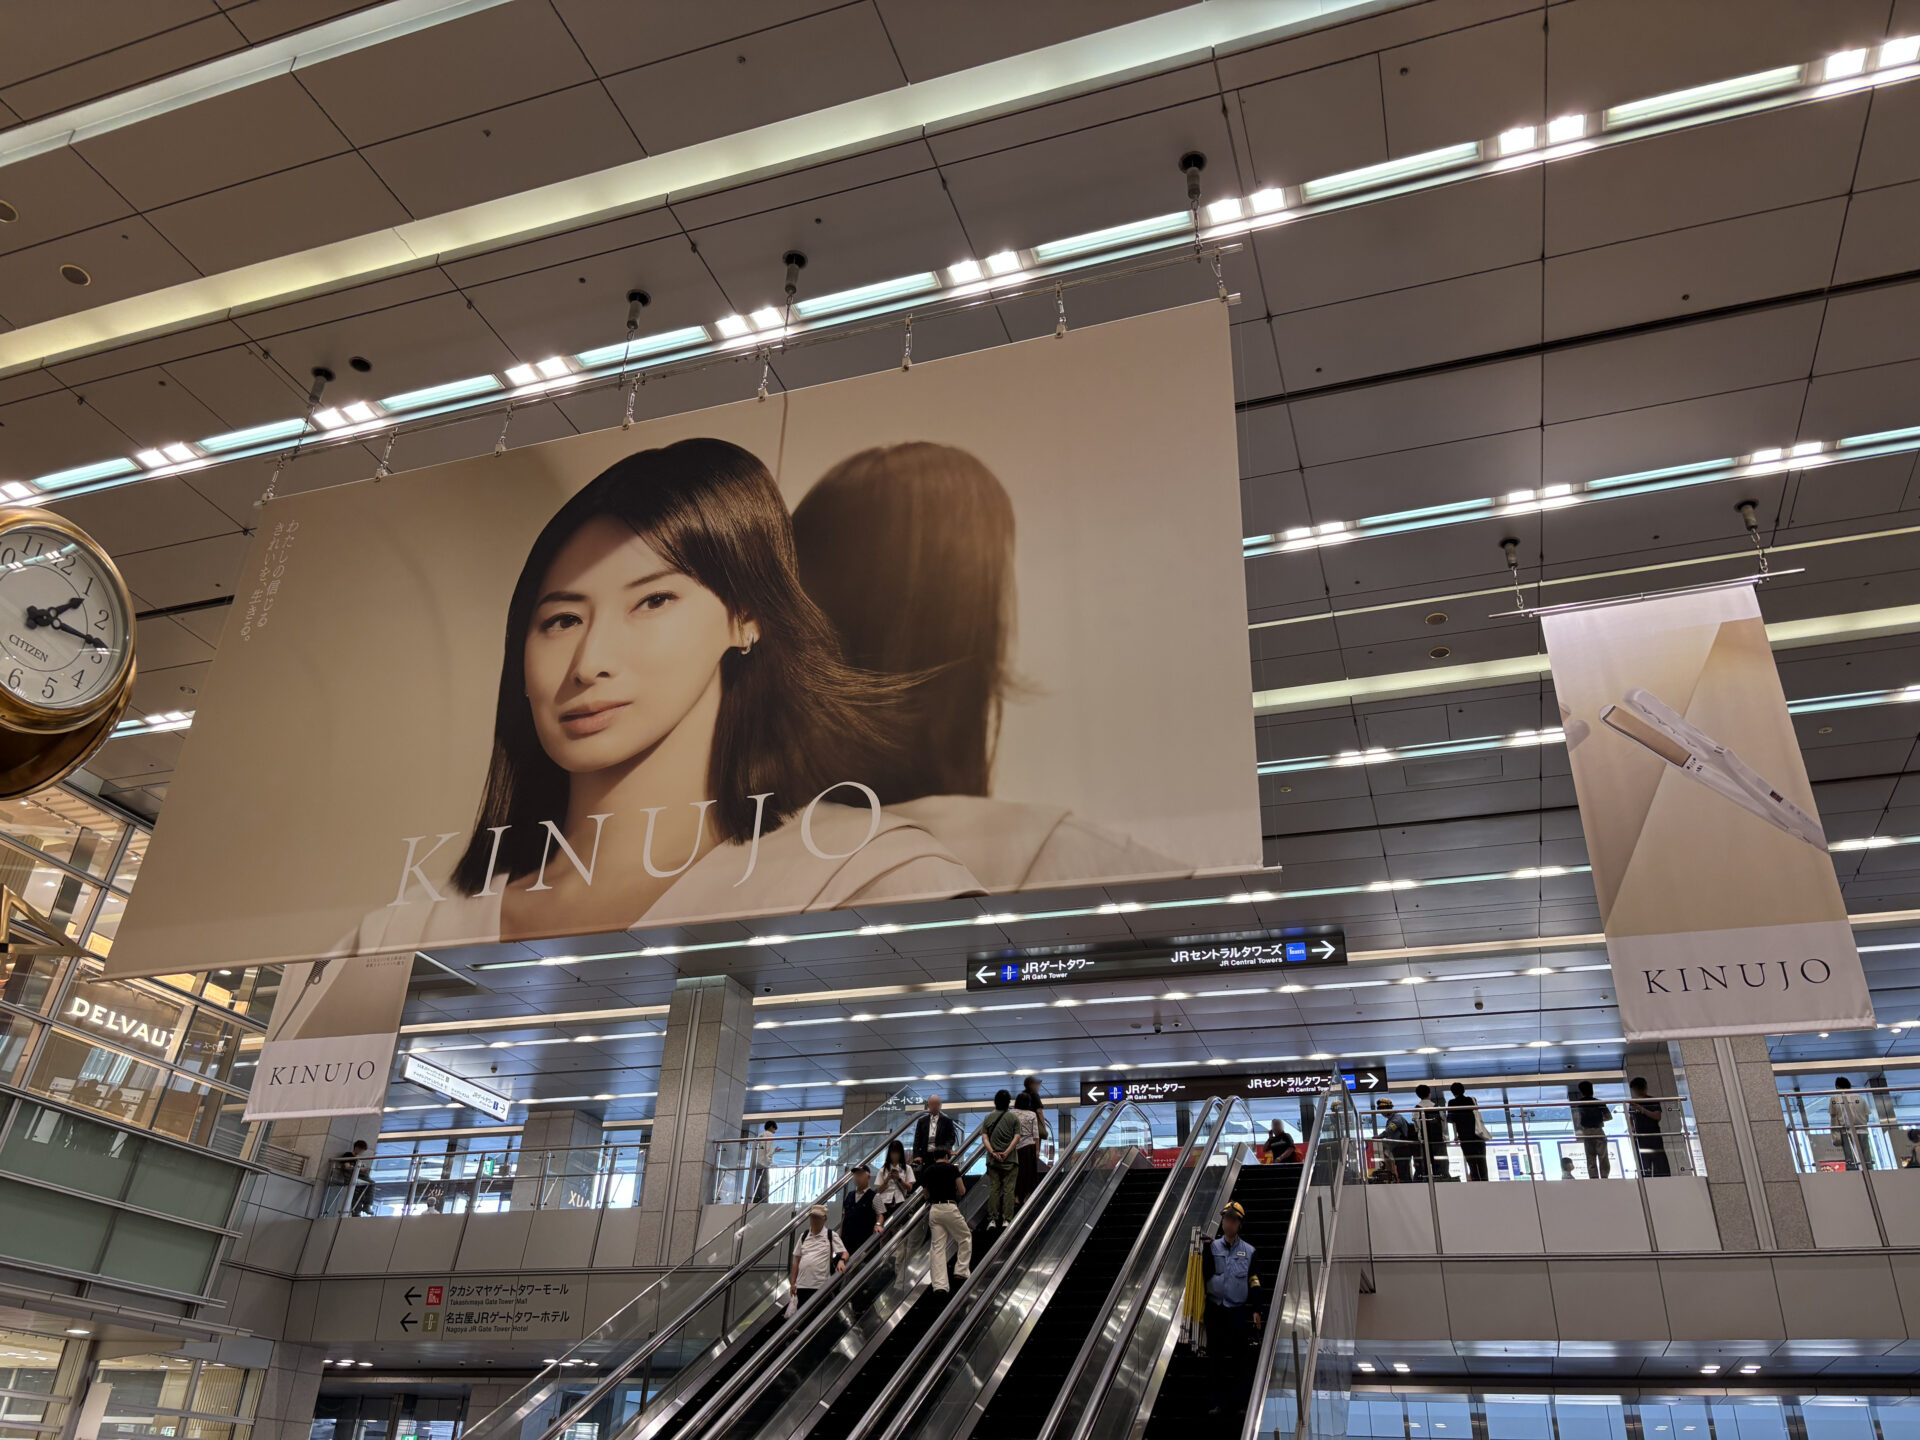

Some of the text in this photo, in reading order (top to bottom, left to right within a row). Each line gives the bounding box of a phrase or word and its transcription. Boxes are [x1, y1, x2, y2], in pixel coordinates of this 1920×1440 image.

[0, 541, 16, 566] 0
[22, 535, 43, 558] 11
[257, 520, 300, 628] わたしの信じる
[83, 577, 94, 596] 1
[94, 609, 110, 631] 2
[8, 634, 49, 663] CITIZEN
[7, 668, 24, 690] 6
[41, 677, 58, 699] 5
[71, 669, 86, 690] 4
[387, 781, 882, 907] KINUJO
[1171, 944, 1282, 963] JRセントラルタワーズ
[1021, 959, 1095, 974] JRゲートタワー
[1641, 958, 1831, 994] KINUJO
[268, 1060, 375, 1086] KINUJO
[1125, 1083, 1186, 1095] JRゲートタワー
[449, 1283, 569, 1297] タカシマヤゲートタワーモール
[446, 1310, 570, 1324] 名古屋JRゲートタワーホテル
